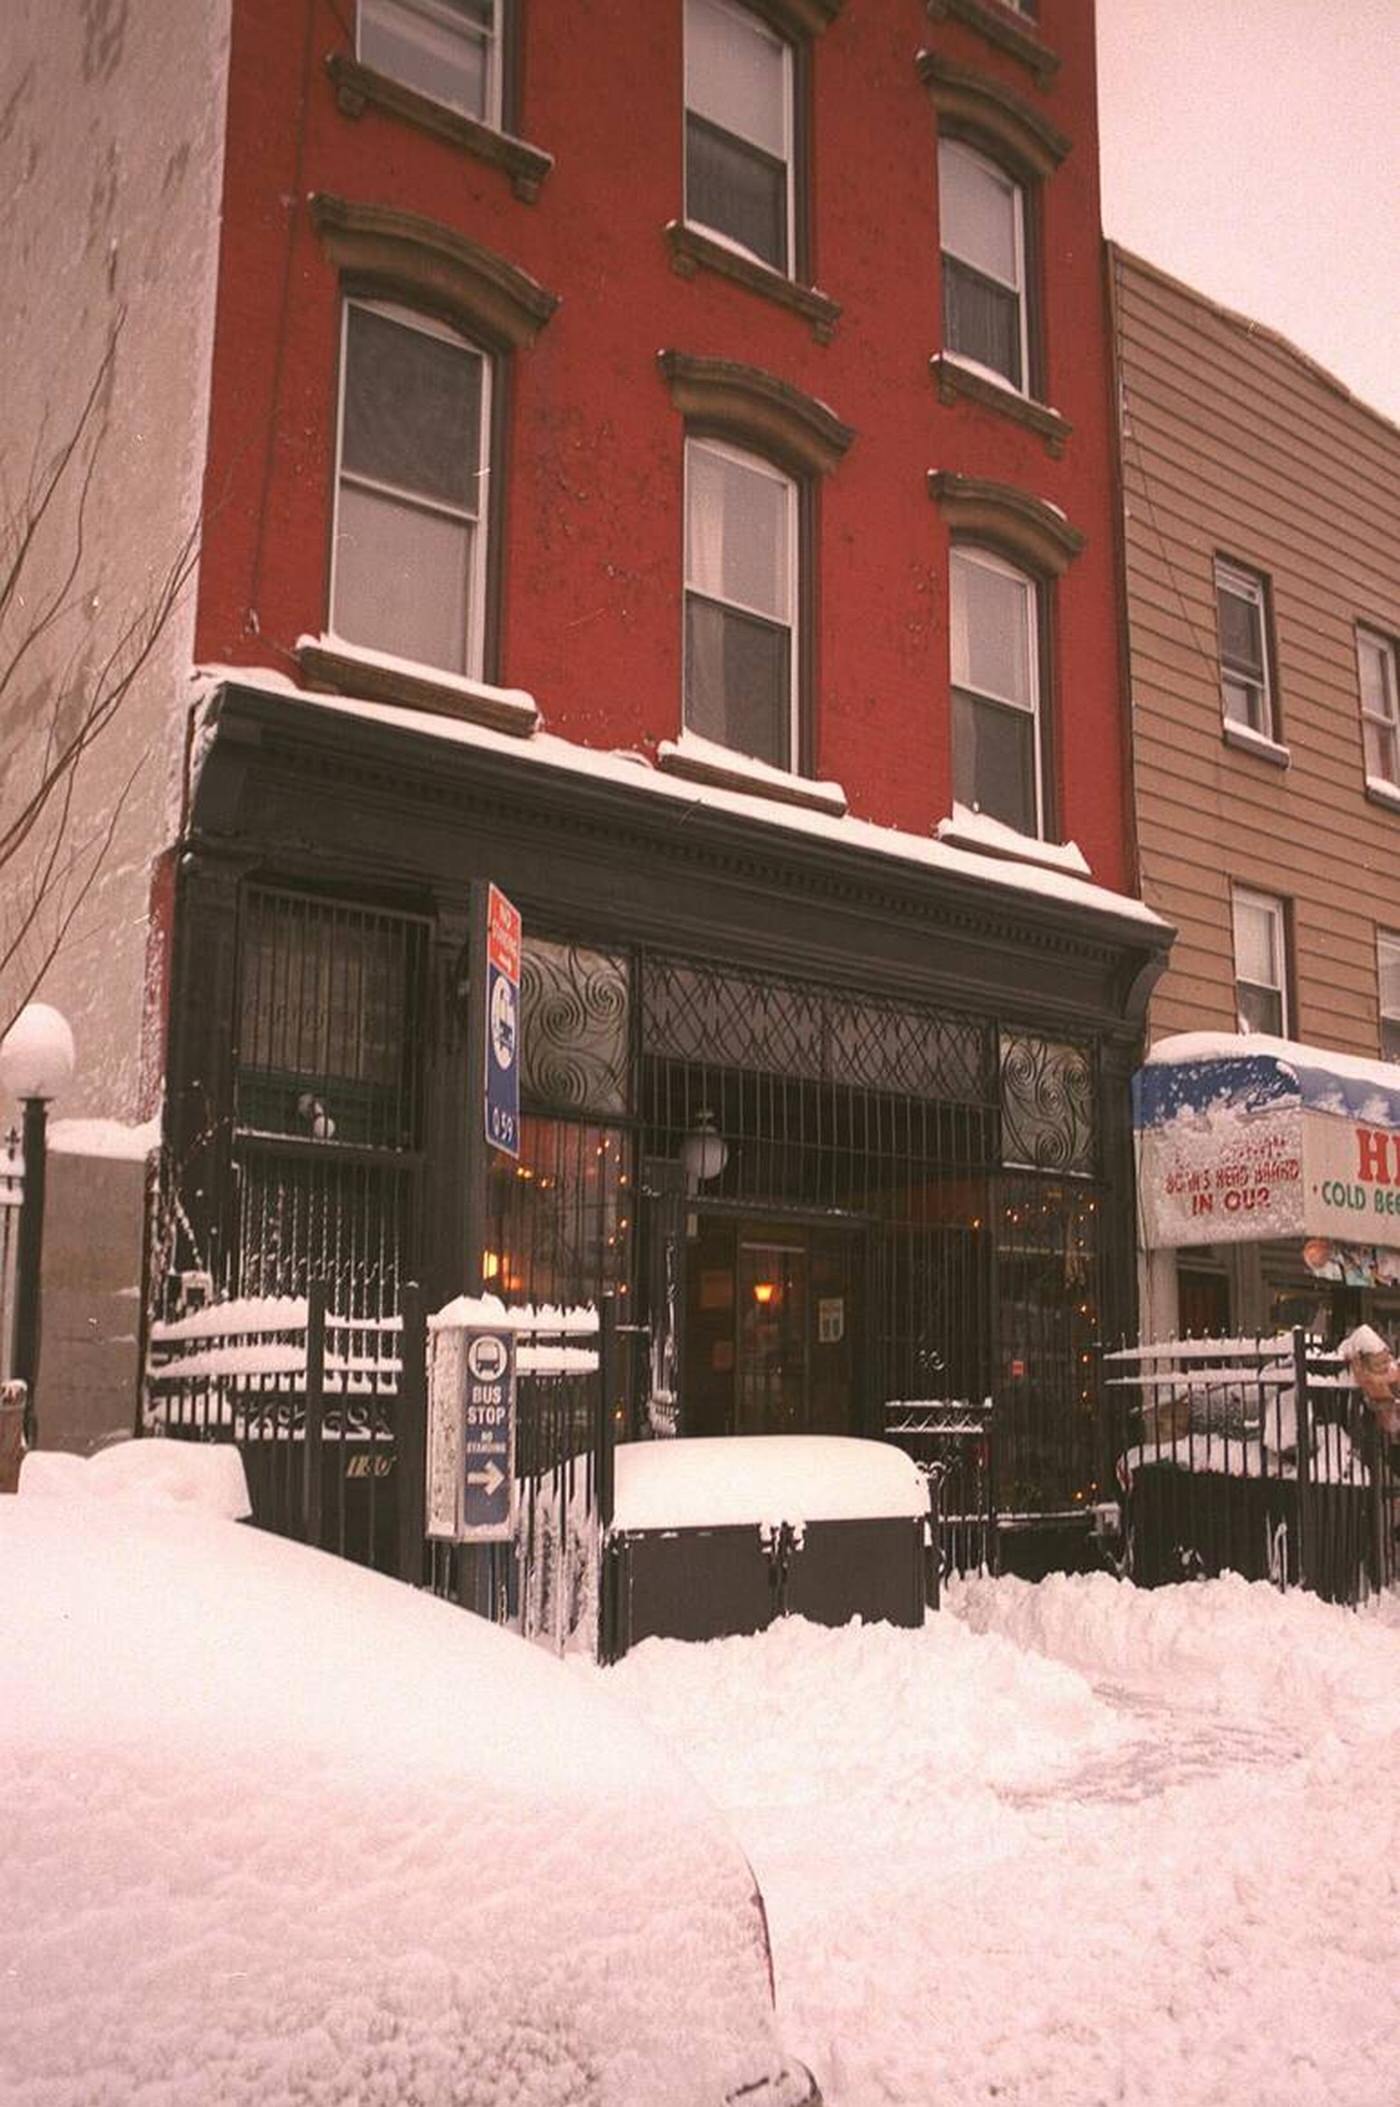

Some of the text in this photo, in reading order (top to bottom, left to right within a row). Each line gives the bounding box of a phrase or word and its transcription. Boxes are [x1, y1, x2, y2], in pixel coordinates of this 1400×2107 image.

[1192, 1193, 1213, 1216] IN
[1322, 1181, 1366, 1211] COLD
[473, 1386, 502, 1405] BUS
[467, 1405, 506, 1426] STOP
